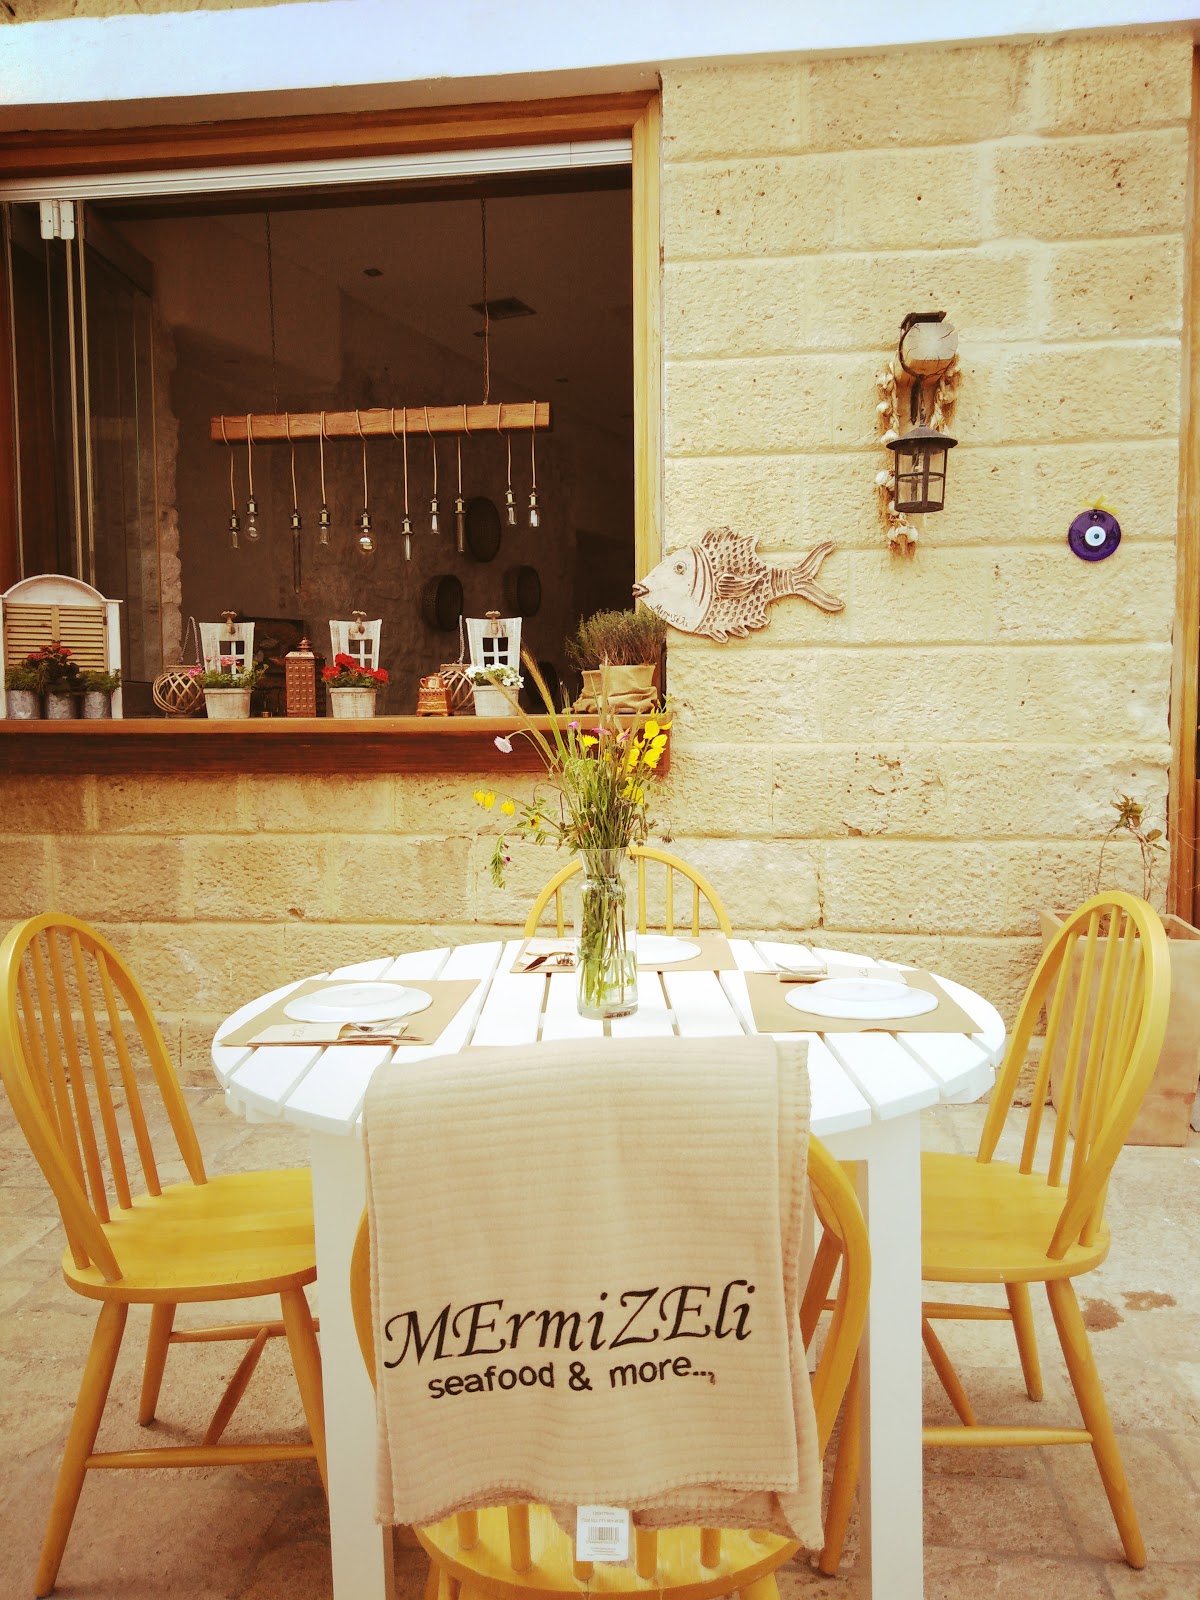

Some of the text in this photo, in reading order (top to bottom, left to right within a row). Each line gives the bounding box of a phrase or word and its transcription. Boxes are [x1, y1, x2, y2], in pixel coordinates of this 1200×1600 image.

[383, 1279, 757, 1369] MErmiZEli
[427, 1361, 556, 1400] seafood
[568, 1361, 594, 1392] &
